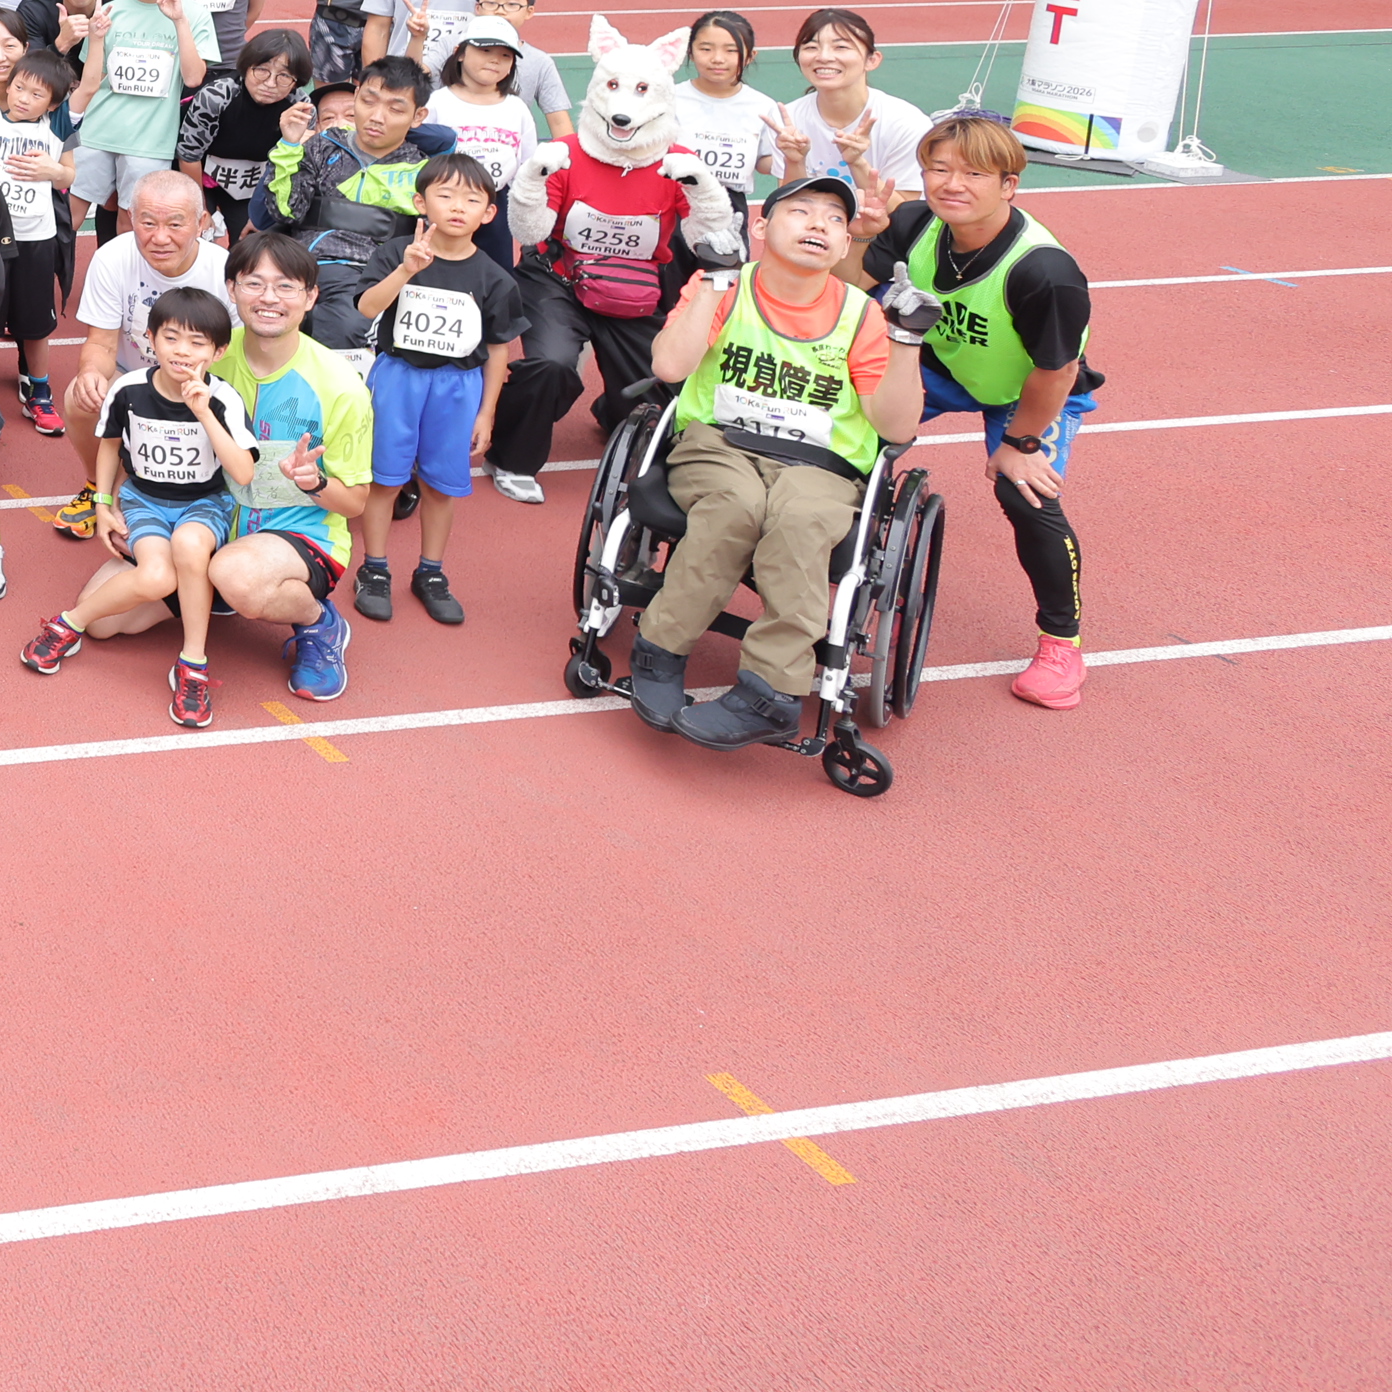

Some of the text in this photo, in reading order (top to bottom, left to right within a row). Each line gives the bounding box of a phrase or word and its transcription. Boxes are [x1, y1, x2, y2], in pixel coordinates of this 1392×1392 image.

[114, 65, 160, 83] 4029
[691, 148, 746, 169] 4023
[0, 181, 36, 204] 030
[577, 227, 641, 249] 4258
[580, 242, 632, 257] Fun RUN
[399, 308, 464, 339] 4024
[403, 334, 455, 352] Fun RUN
[719, 341, 844, 411] 視覚障害
[136, 441, 202, 467] 4052
[143, 466, 196, 480] Fun RUN
